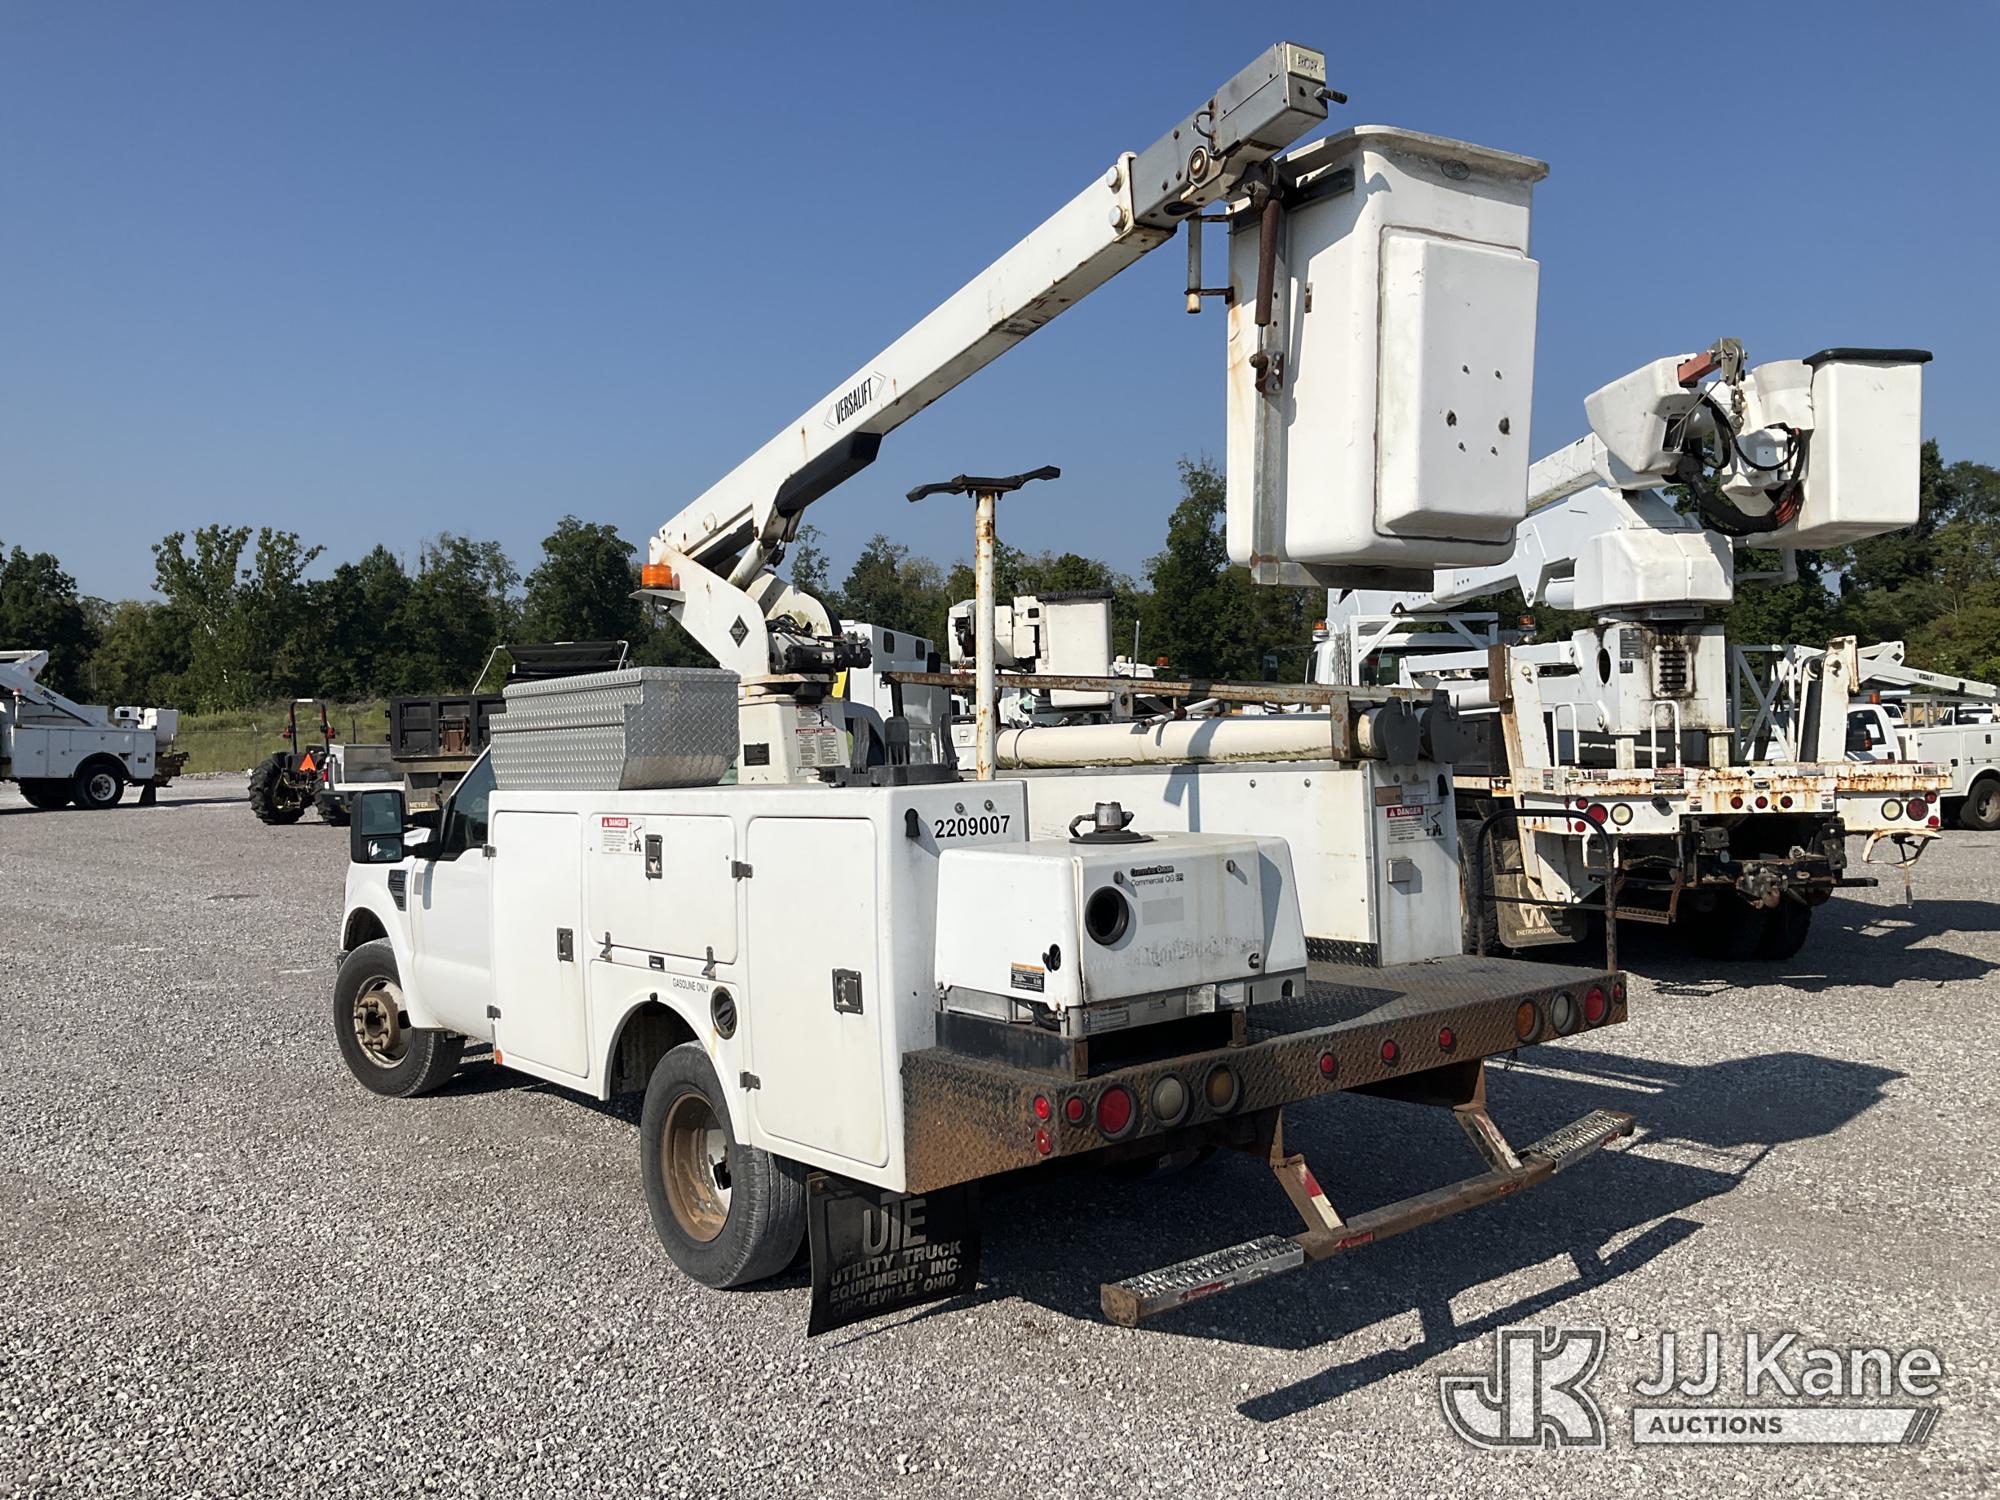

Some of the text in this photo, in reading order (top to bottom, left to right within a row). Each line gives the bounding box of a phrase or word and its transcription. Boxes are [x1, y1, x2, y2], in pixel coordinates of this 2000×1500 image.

[835, 376, 873, 425] VERSALIFT
[934, 814, 1011, 839] 2209007
[1396, 807, 1422, 816] DANGER
[673, 977, 709, 993] GASOLINE ONLY
[862, 1191, 927, 1257] UTE
[830, 1256, 963, 1302] EQUIPMENT, INC.
[831, 1240, 962, 1287] UTILITY TRUCK
[923, 1273, 956, 1292] OHIO
